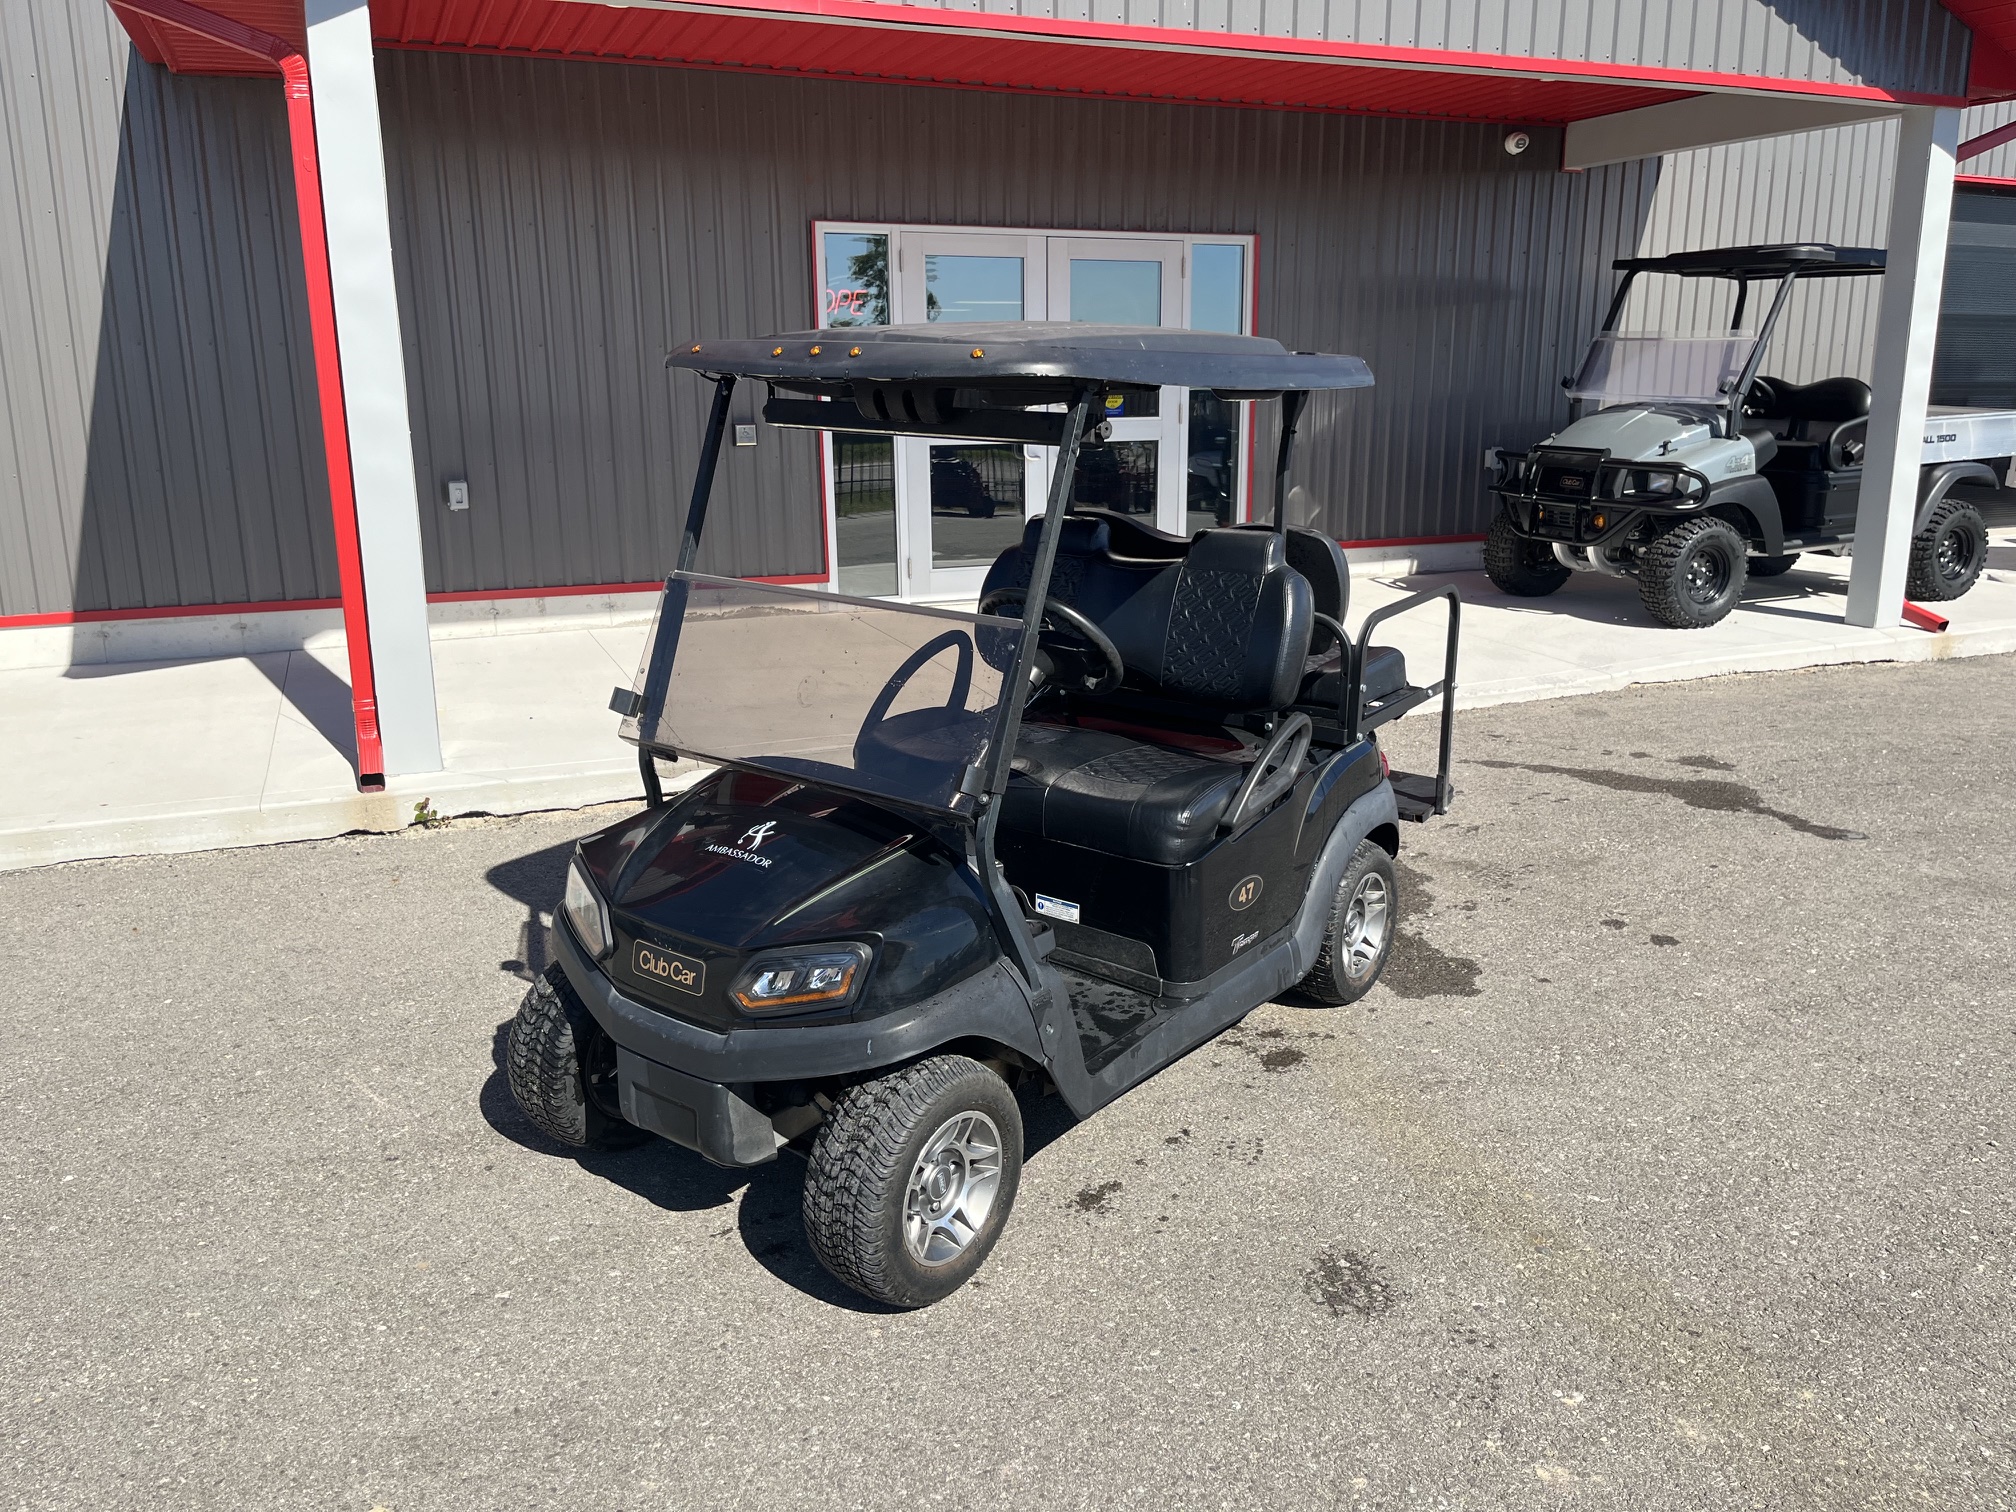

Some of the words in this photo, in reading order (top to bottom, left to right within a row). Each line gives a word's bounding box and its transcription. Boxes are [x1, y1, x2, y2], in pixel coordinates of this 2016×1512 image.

[1936, 433, 1957, 443] 1500
[704, 844, 773, 869] AMBASSADOR
[1238, 881, 1255, 903] 47
[639, 950, 669, 977] Club
[670, 961, 697, 986] Car
